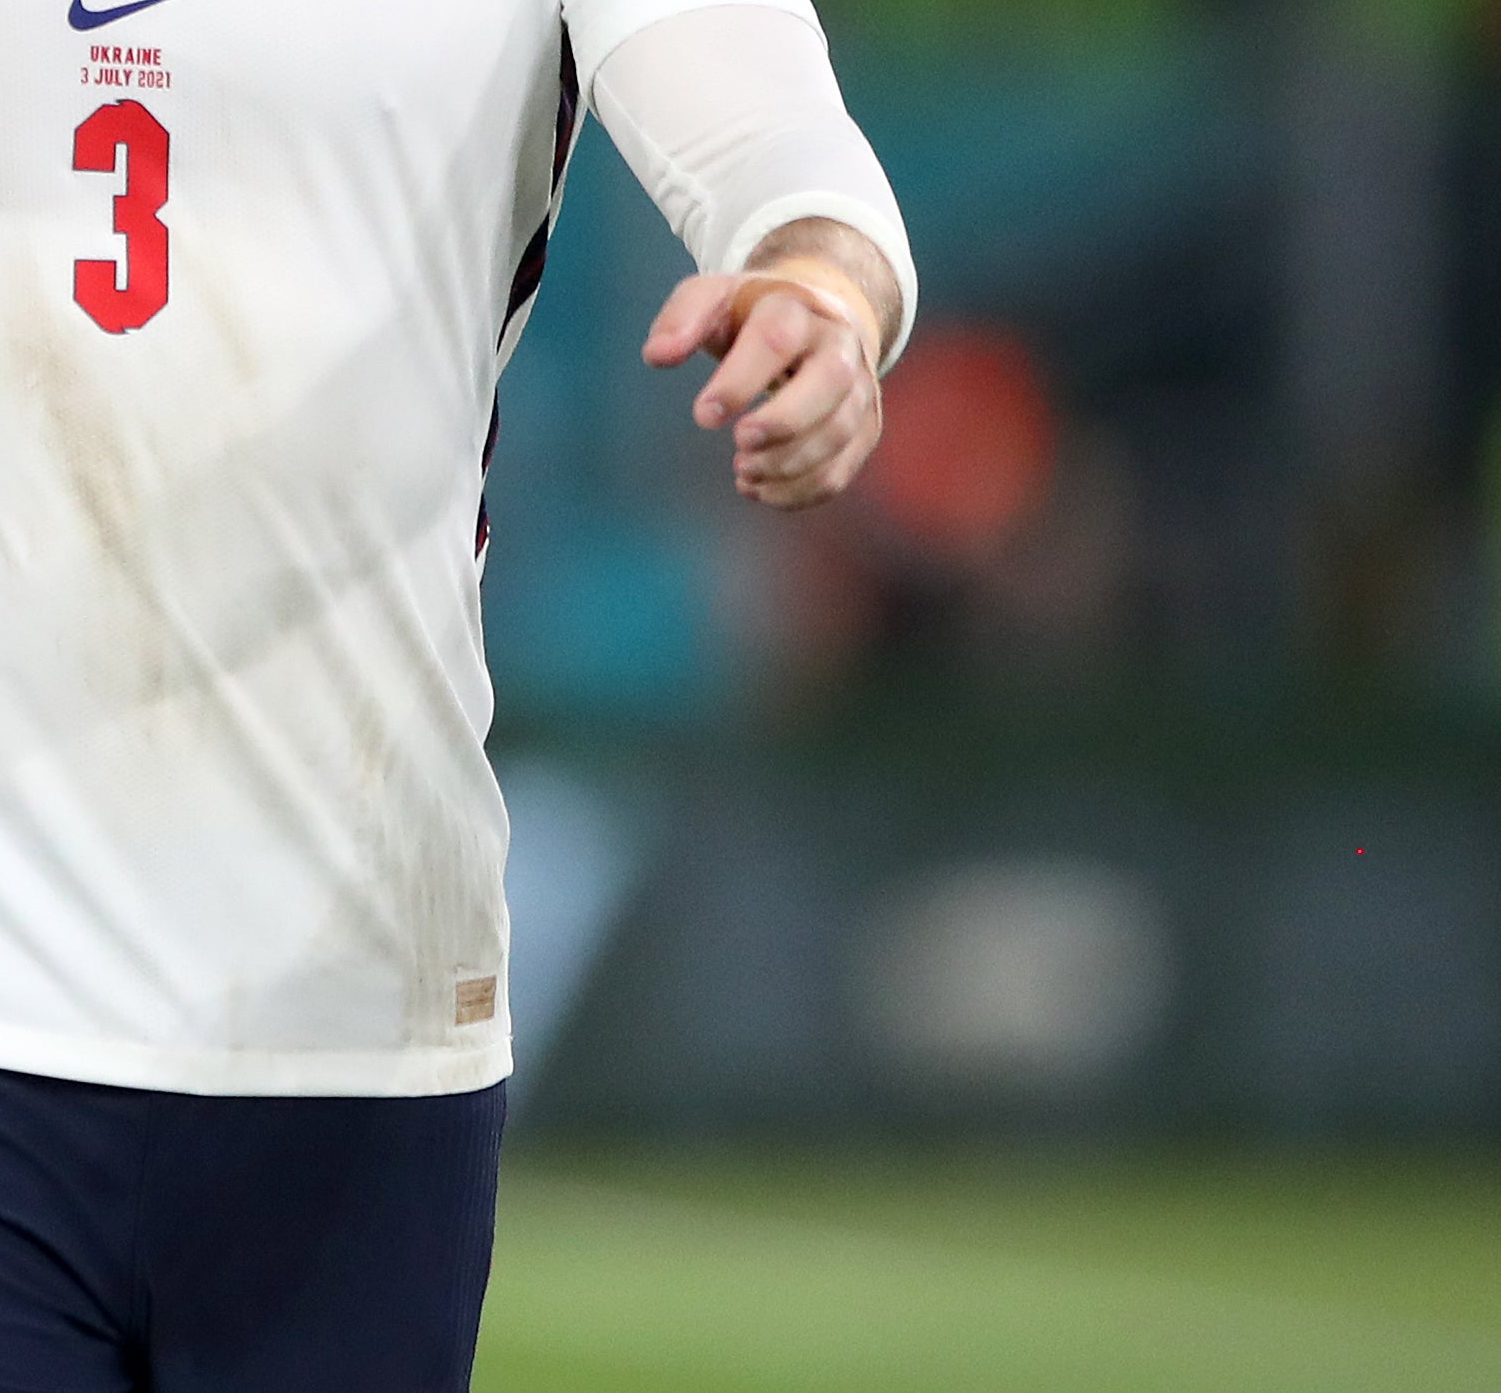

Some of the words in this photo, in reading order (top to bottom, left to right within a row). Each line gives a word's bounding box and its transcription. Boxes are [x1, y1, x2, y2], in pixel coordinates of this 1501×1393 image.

[90, 45, 162, 66] UKRAINE
[81, 67, 89, 84] 3
[94, 68, 133, 86] JULY
[138, 70, 171, 89] 2021
[73, 99, 169, 334] 3
